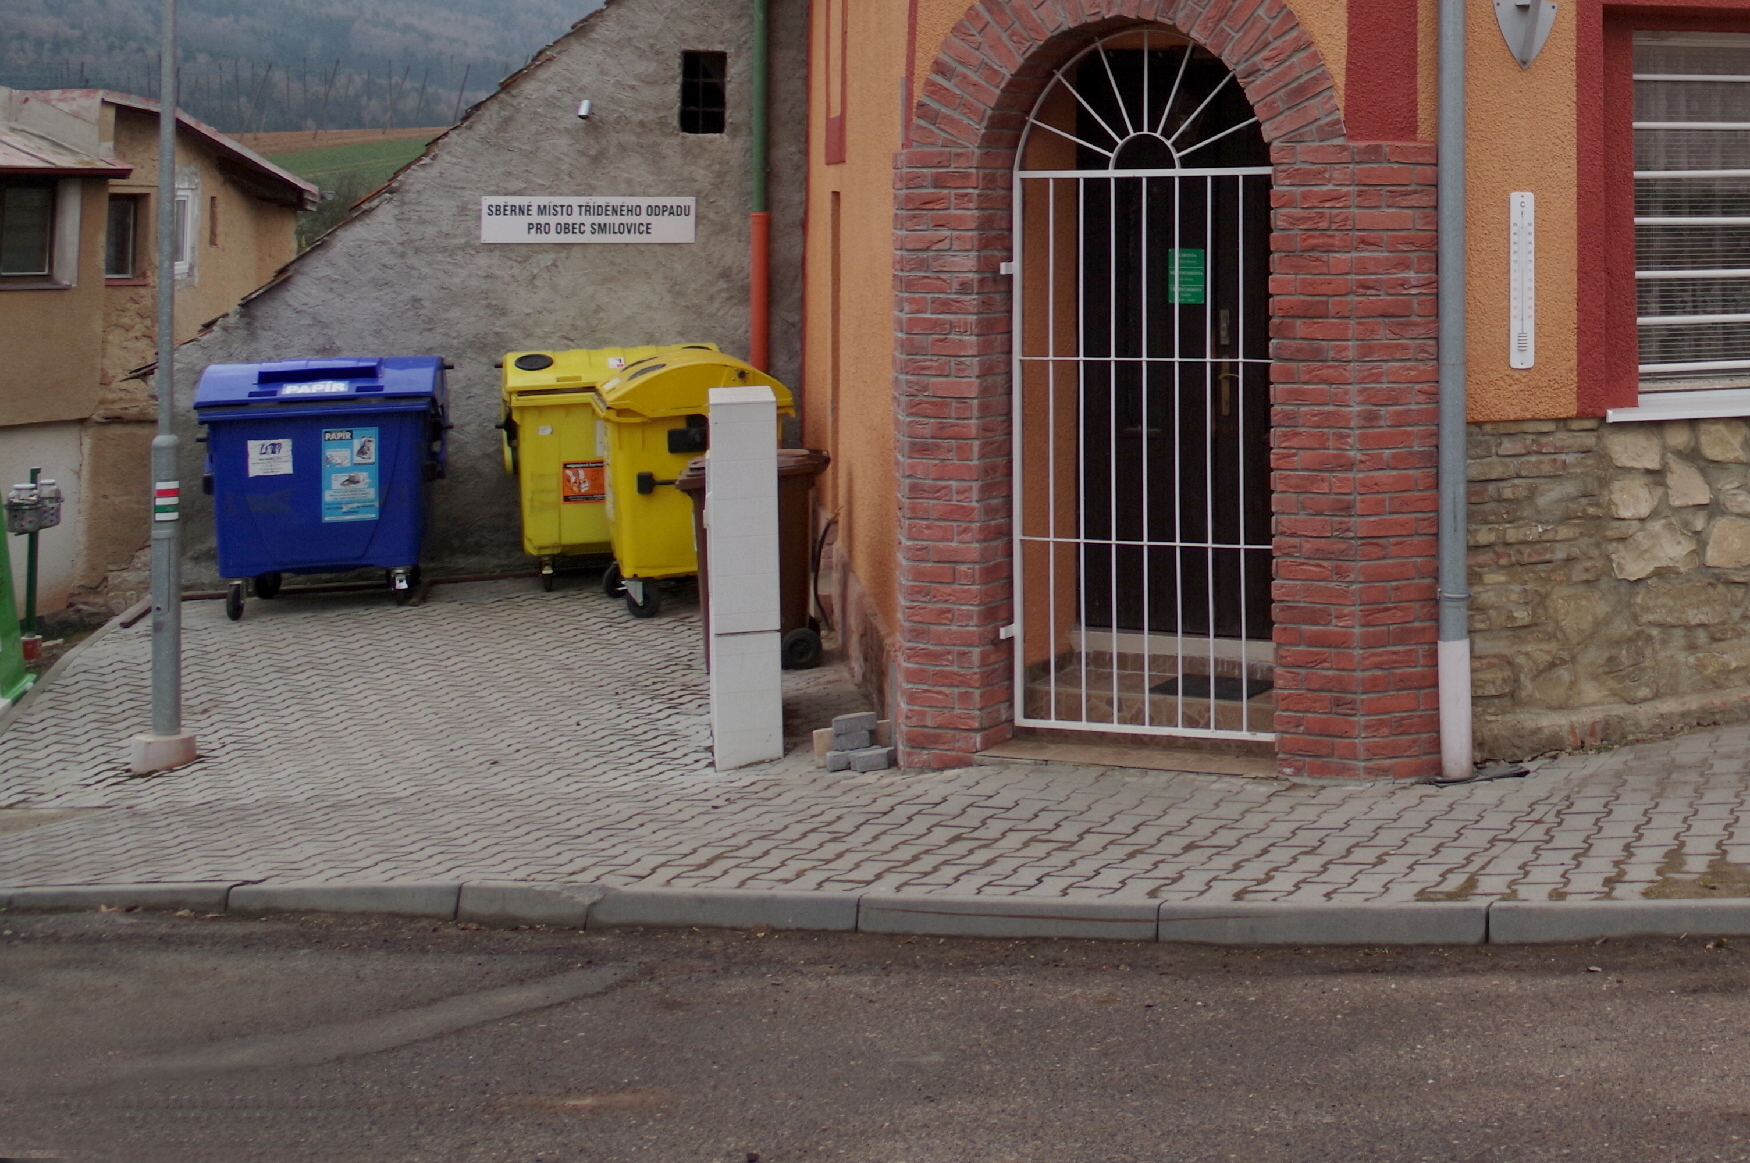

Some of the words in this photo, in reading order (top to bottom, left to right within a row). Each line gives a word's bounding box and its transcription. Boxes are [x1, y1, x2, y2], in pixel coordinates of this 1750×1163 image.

[487, 201, 533, 217] SBĚRNÉ
[537, 201, 573, 217] MÍSTO
[577, 201, 642, 217] TŘÍDĚNÉHO
[646, 204, 691, 217] ODPADU
[527, 222, 551, 235] PRO
[555, 222, 586, 235] OBEC
[590, 222, 652, 235] SMILOVICE
[285, 381, 345, 394] PAPÍR
